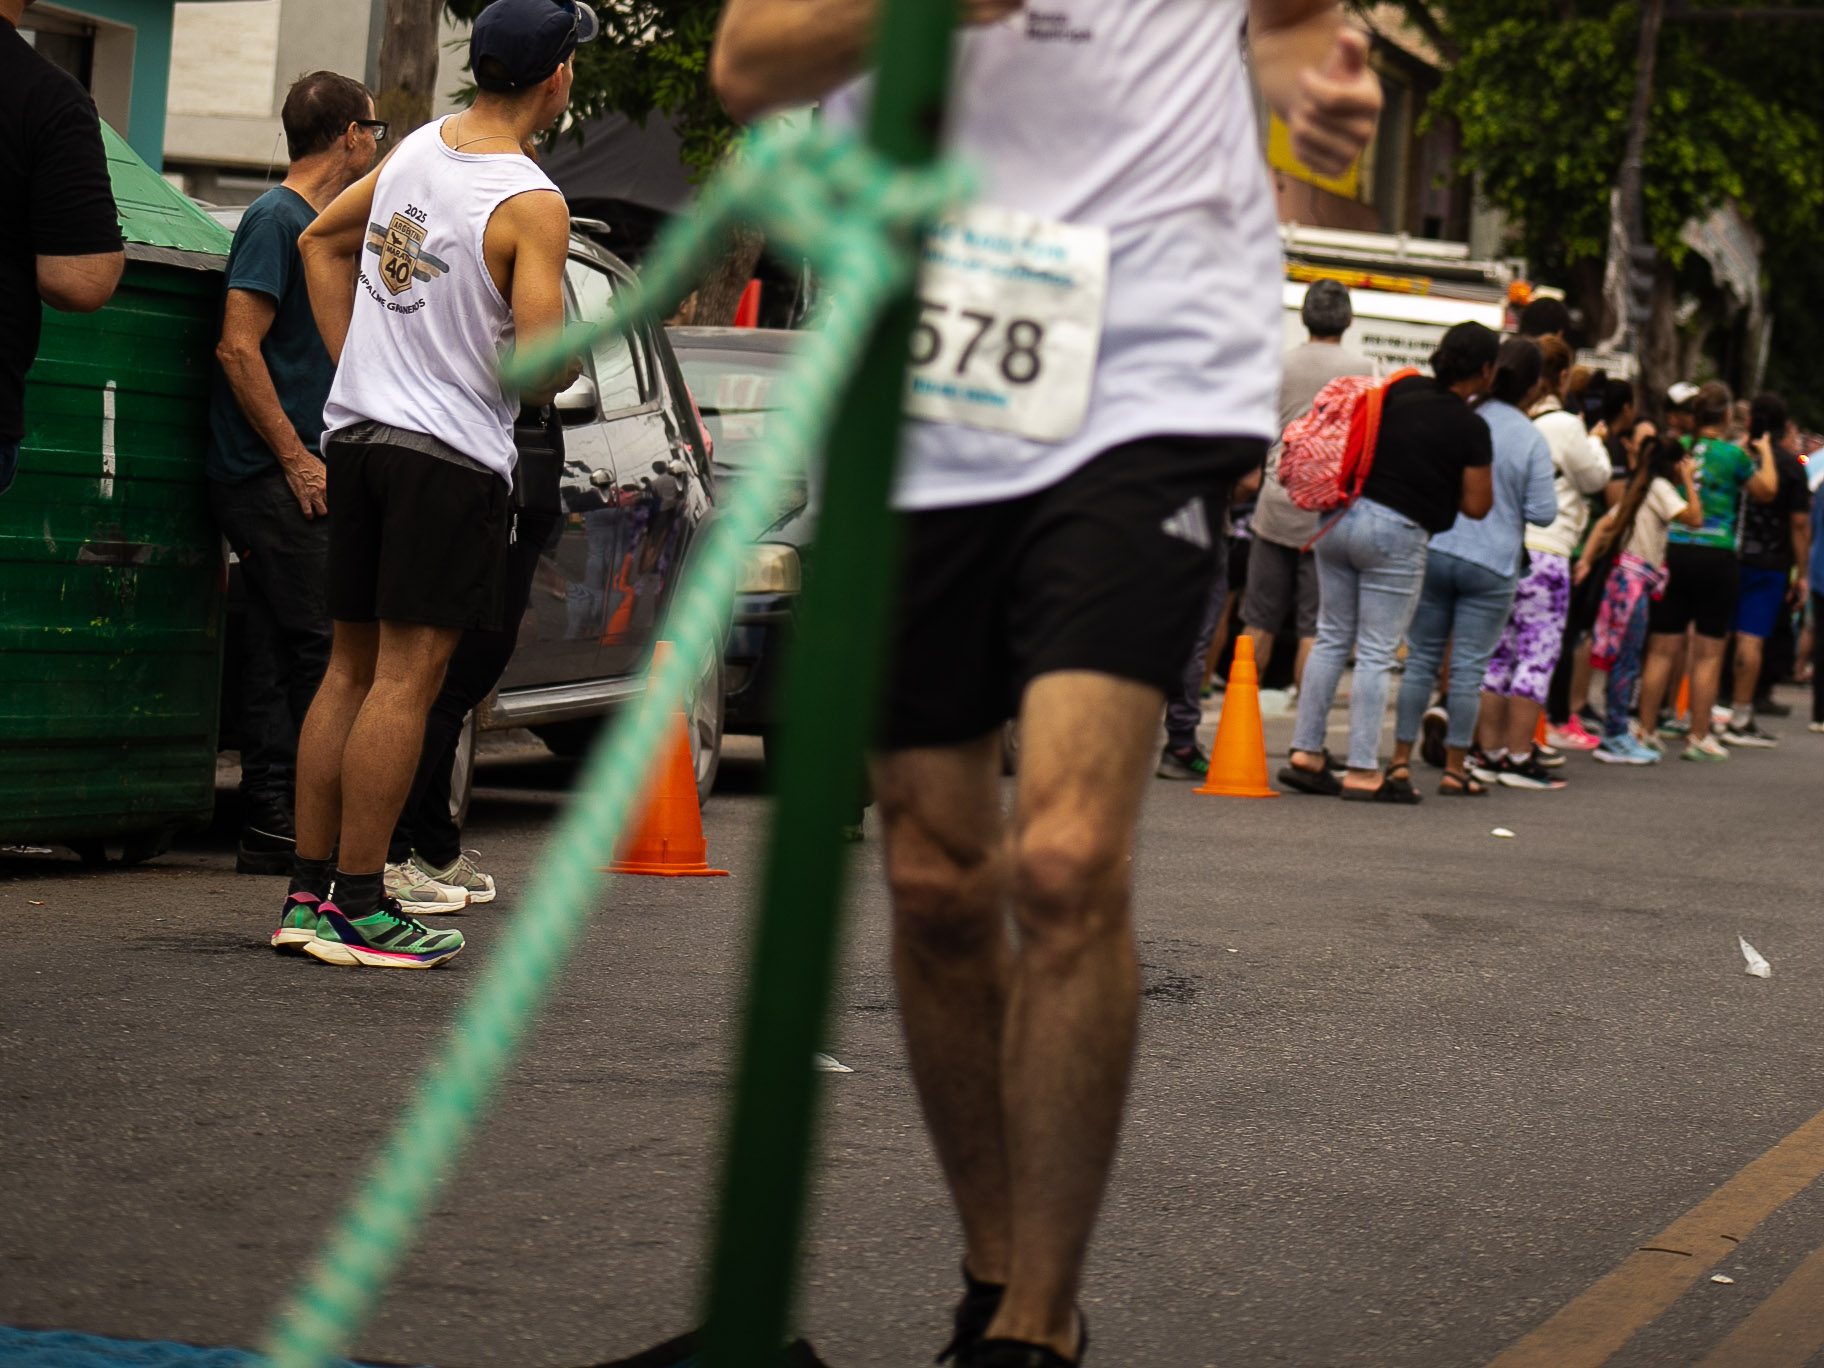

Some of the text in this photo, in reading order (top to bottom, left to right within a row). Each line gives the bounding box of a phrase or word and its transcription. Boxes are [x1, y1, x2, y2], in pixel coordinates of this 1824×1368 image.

[404, 203, 428, 223] 2025
[385, 257, 409, 283] 40
[910, 298, 1044, 386] 578
